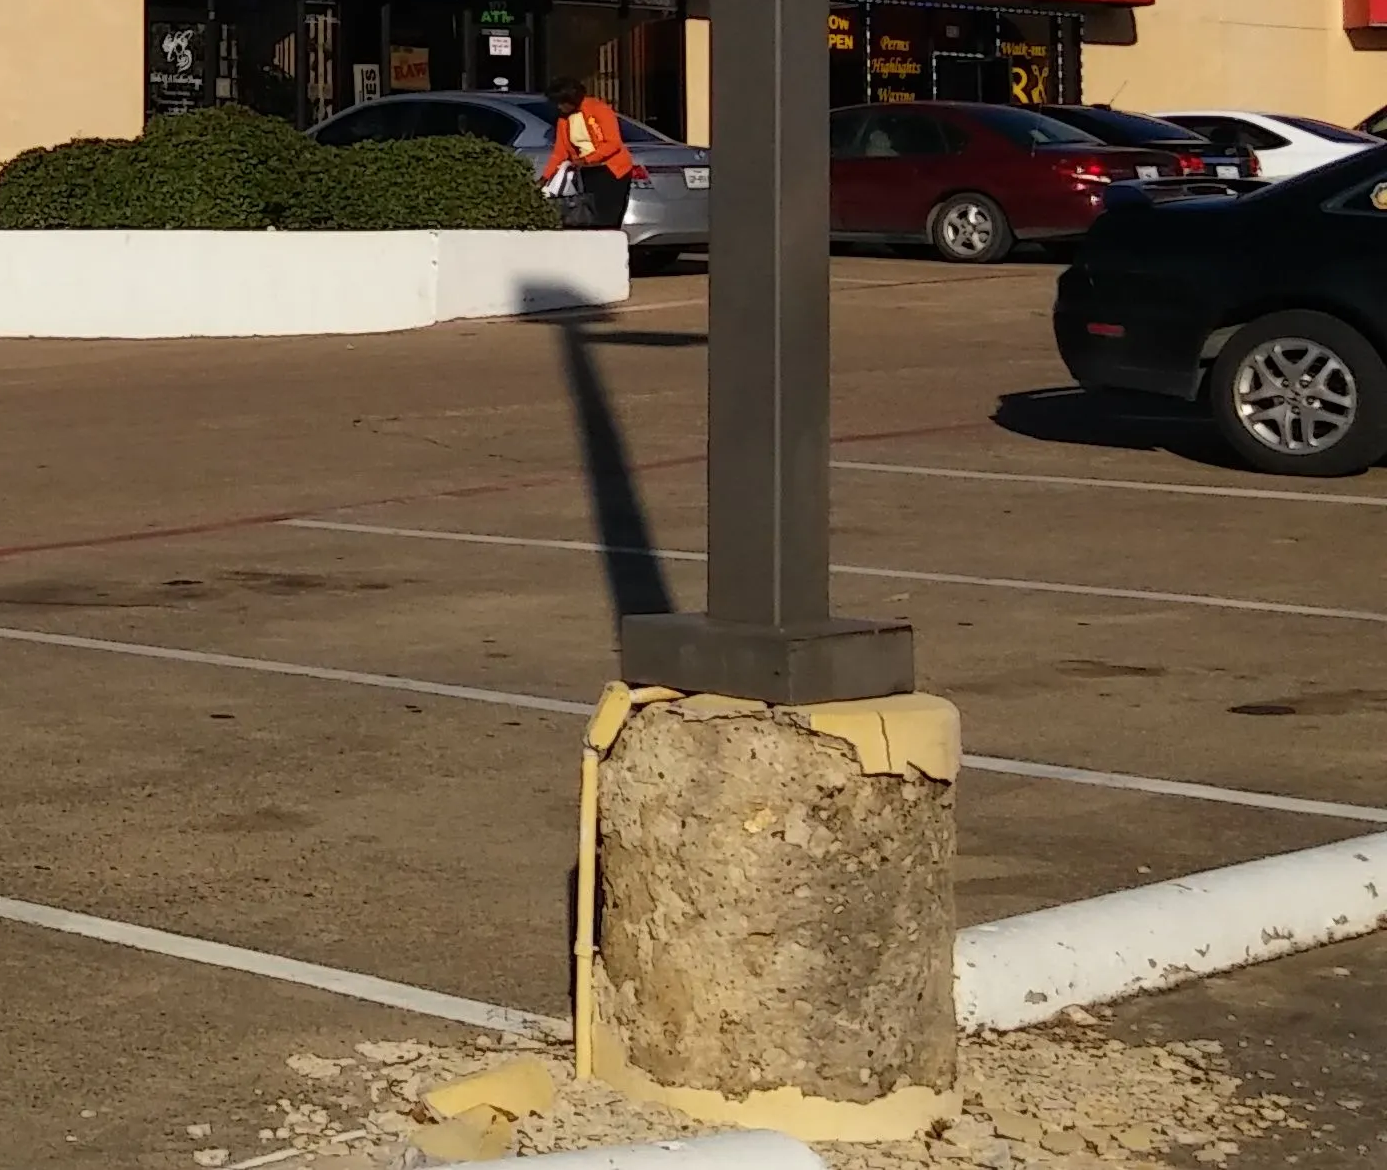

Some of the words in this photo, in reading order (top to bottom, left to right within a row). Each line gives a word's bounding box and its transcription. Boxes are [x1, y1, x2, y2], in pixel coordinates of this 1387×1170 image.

[828, 34, 853, 49] PEN
[394, 63, 427, 80] RAW
[871, 57, 921, 78] Highlights
